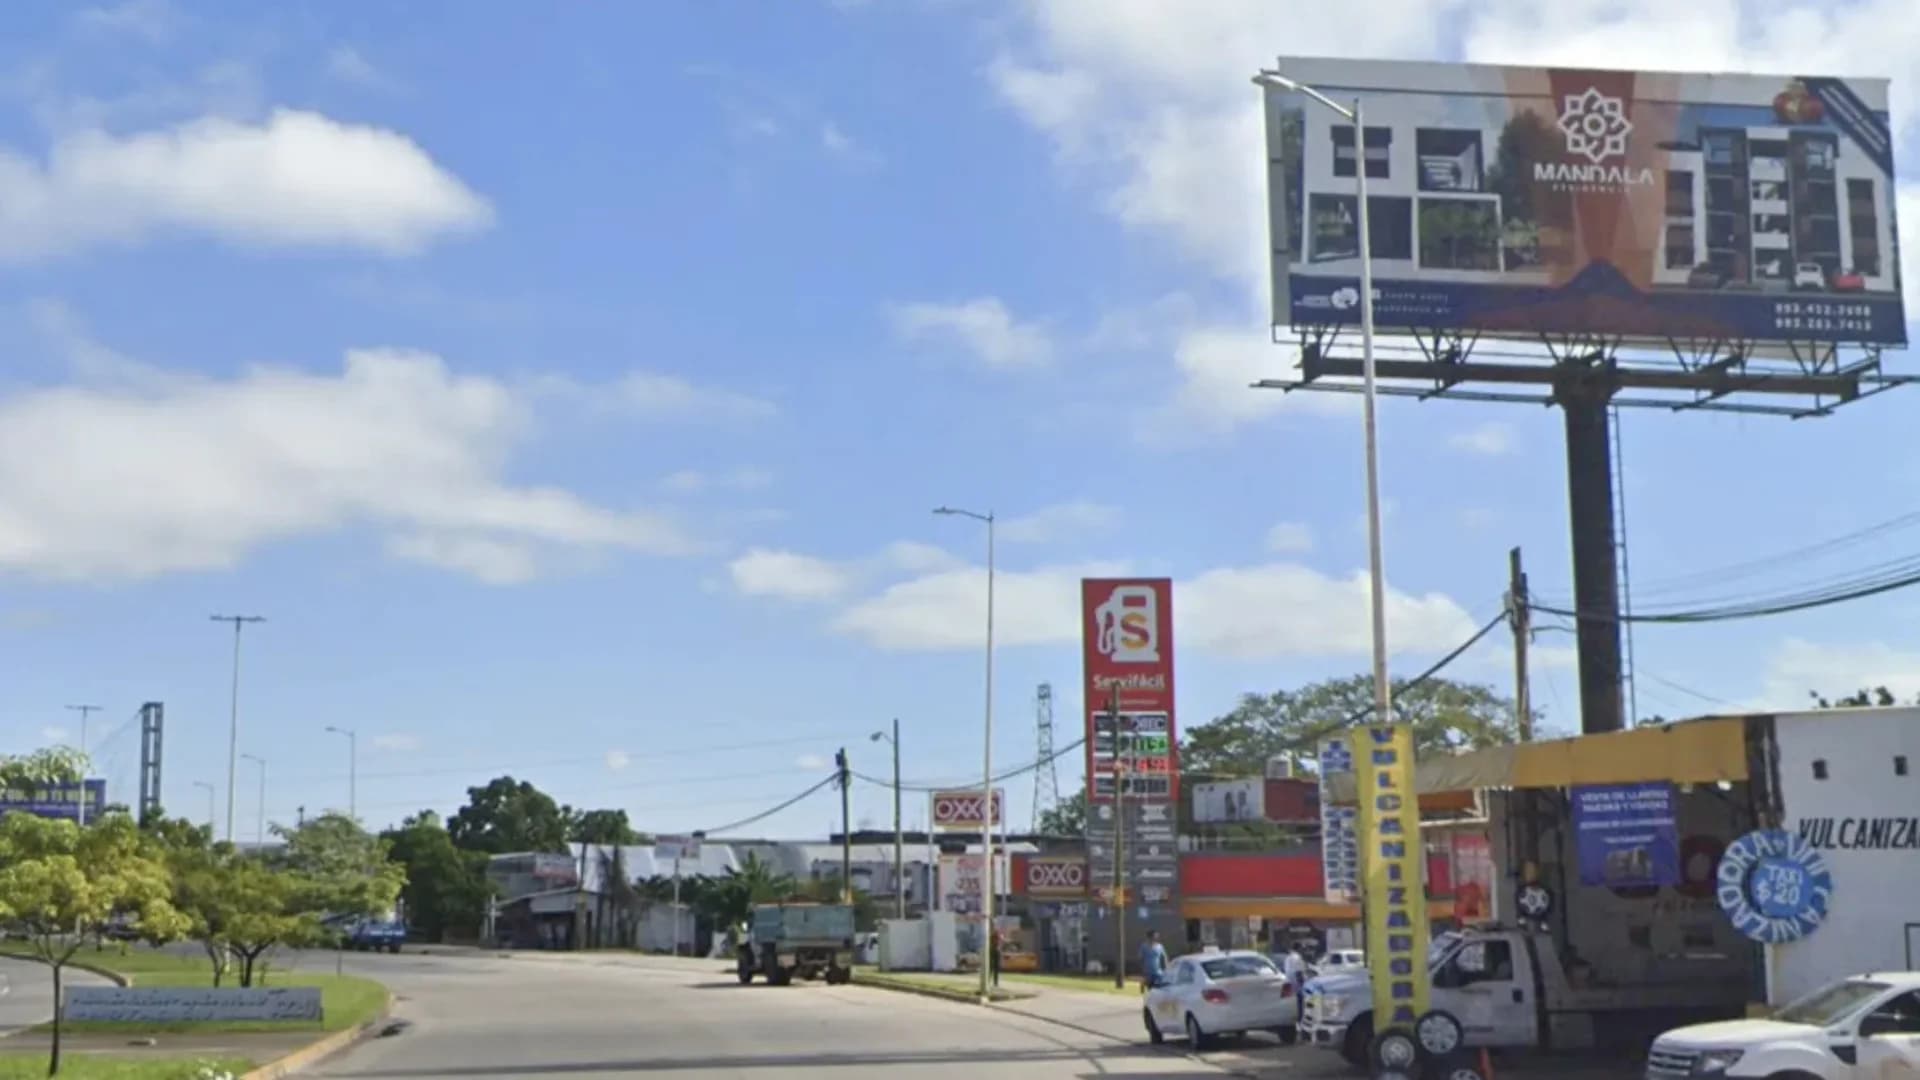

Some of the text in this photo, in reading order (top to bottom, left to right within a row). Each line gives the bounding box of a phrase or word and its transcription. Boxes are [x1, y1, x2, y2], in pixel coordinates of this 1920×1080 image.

[1534, 163, 1654, 185] MANDALA
[936, 799, 998, 822] OXXO
[1800, 817, 1920, 849] VULCANIZA
[1029, 863, 1082, 887] OXXO
